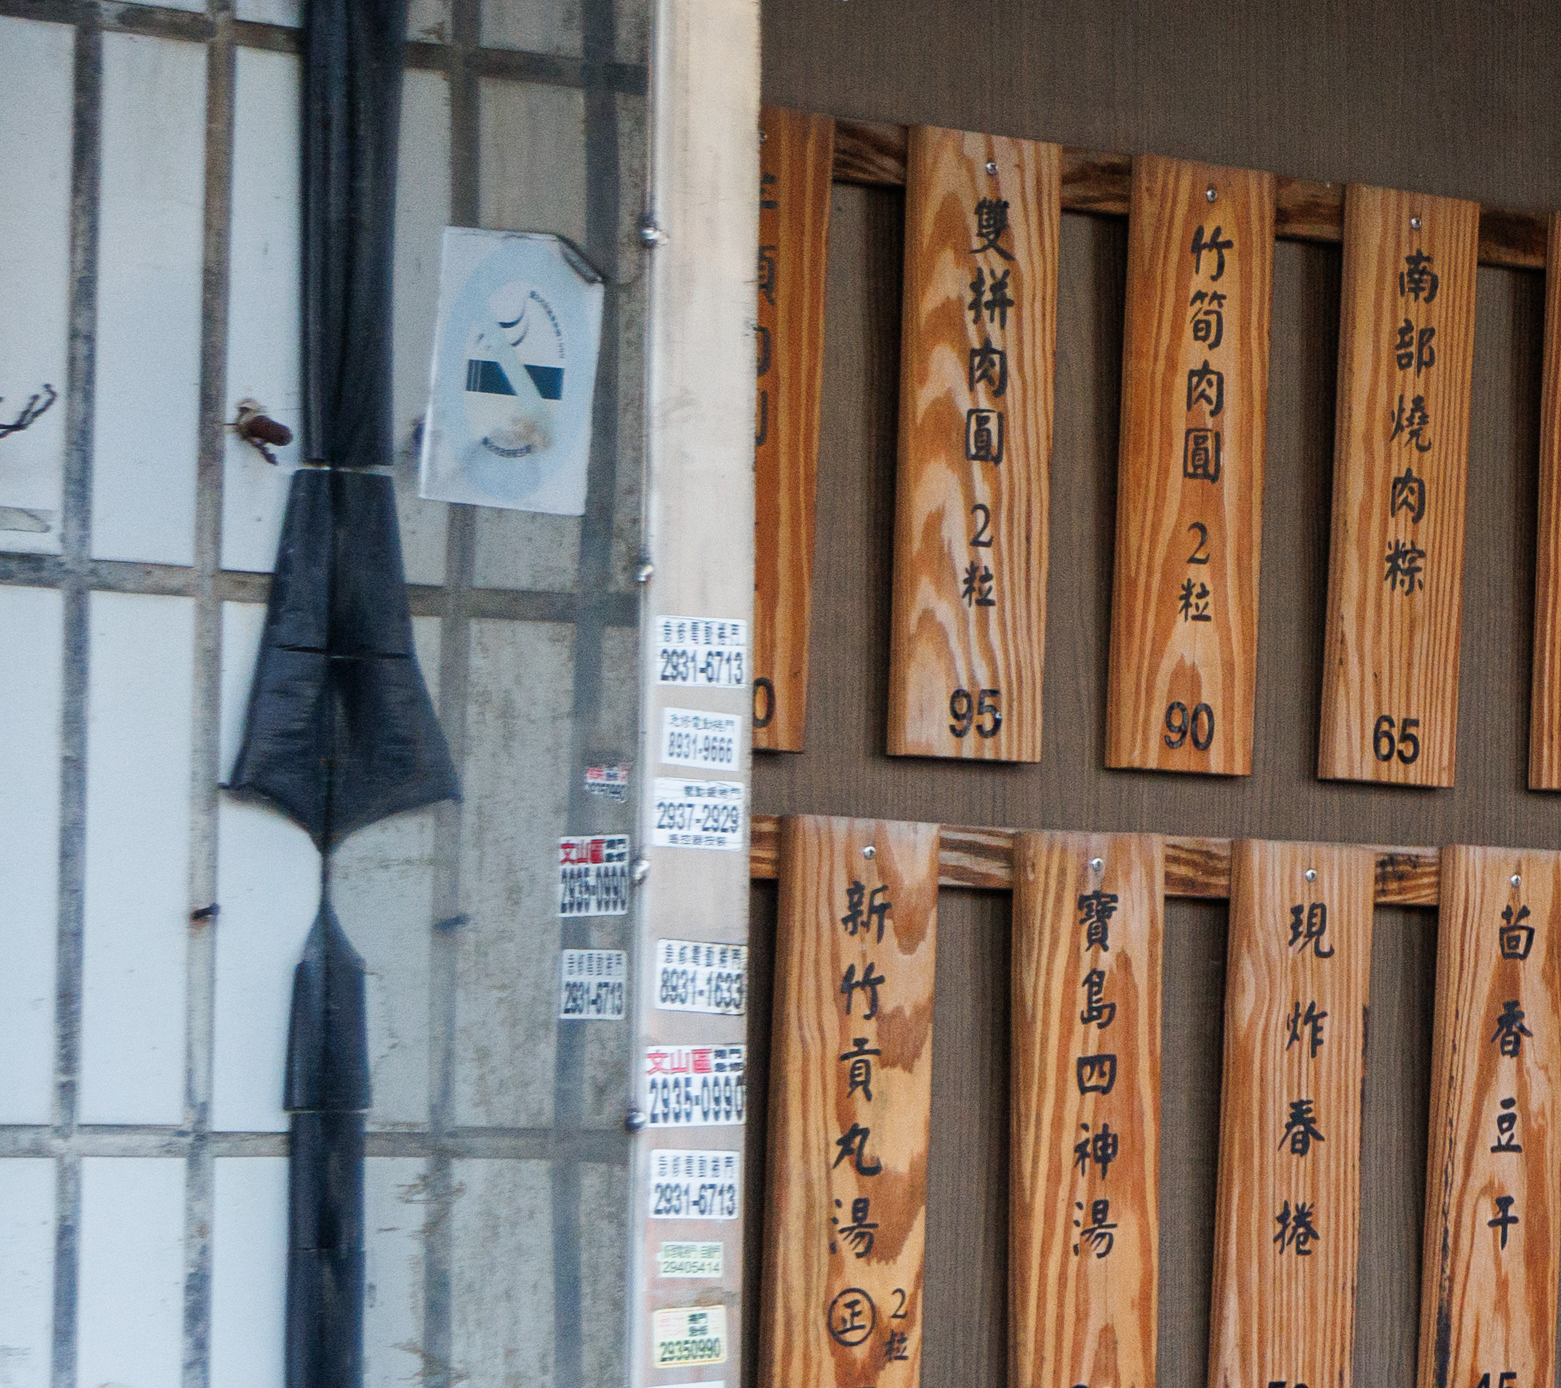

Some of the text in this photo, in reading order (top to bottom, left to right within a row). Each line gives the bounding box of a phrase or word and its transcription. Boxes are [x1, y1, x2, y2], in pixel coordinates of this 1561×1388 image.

[1383, 248, 1440, 597] 南部燒肉粽
[660, 648, 743, 684] 2931-6713
[948, 688, 1002, 739] 95
[1164, 701, 1216, 752] 90
[668, 731, 733, 763] 8931-9666
[1372, 715, 1421, 765] 65
[656, 801, 739, 833] 2937-2929
[660, 967, 744, 1009] 8931-1633
[647, 1048, 713, 1074] 文山區
[829, 880, 893, 1260] 新竹貢丸湯
[1073, 890, 1119, 1260] 寶島四神湯
[1273, 903, 1336, 1256] 現炸春捲
[649, 1075, 745, 1123] 2935-0990
[653, 1182, 736, 1216] 2931-6713
